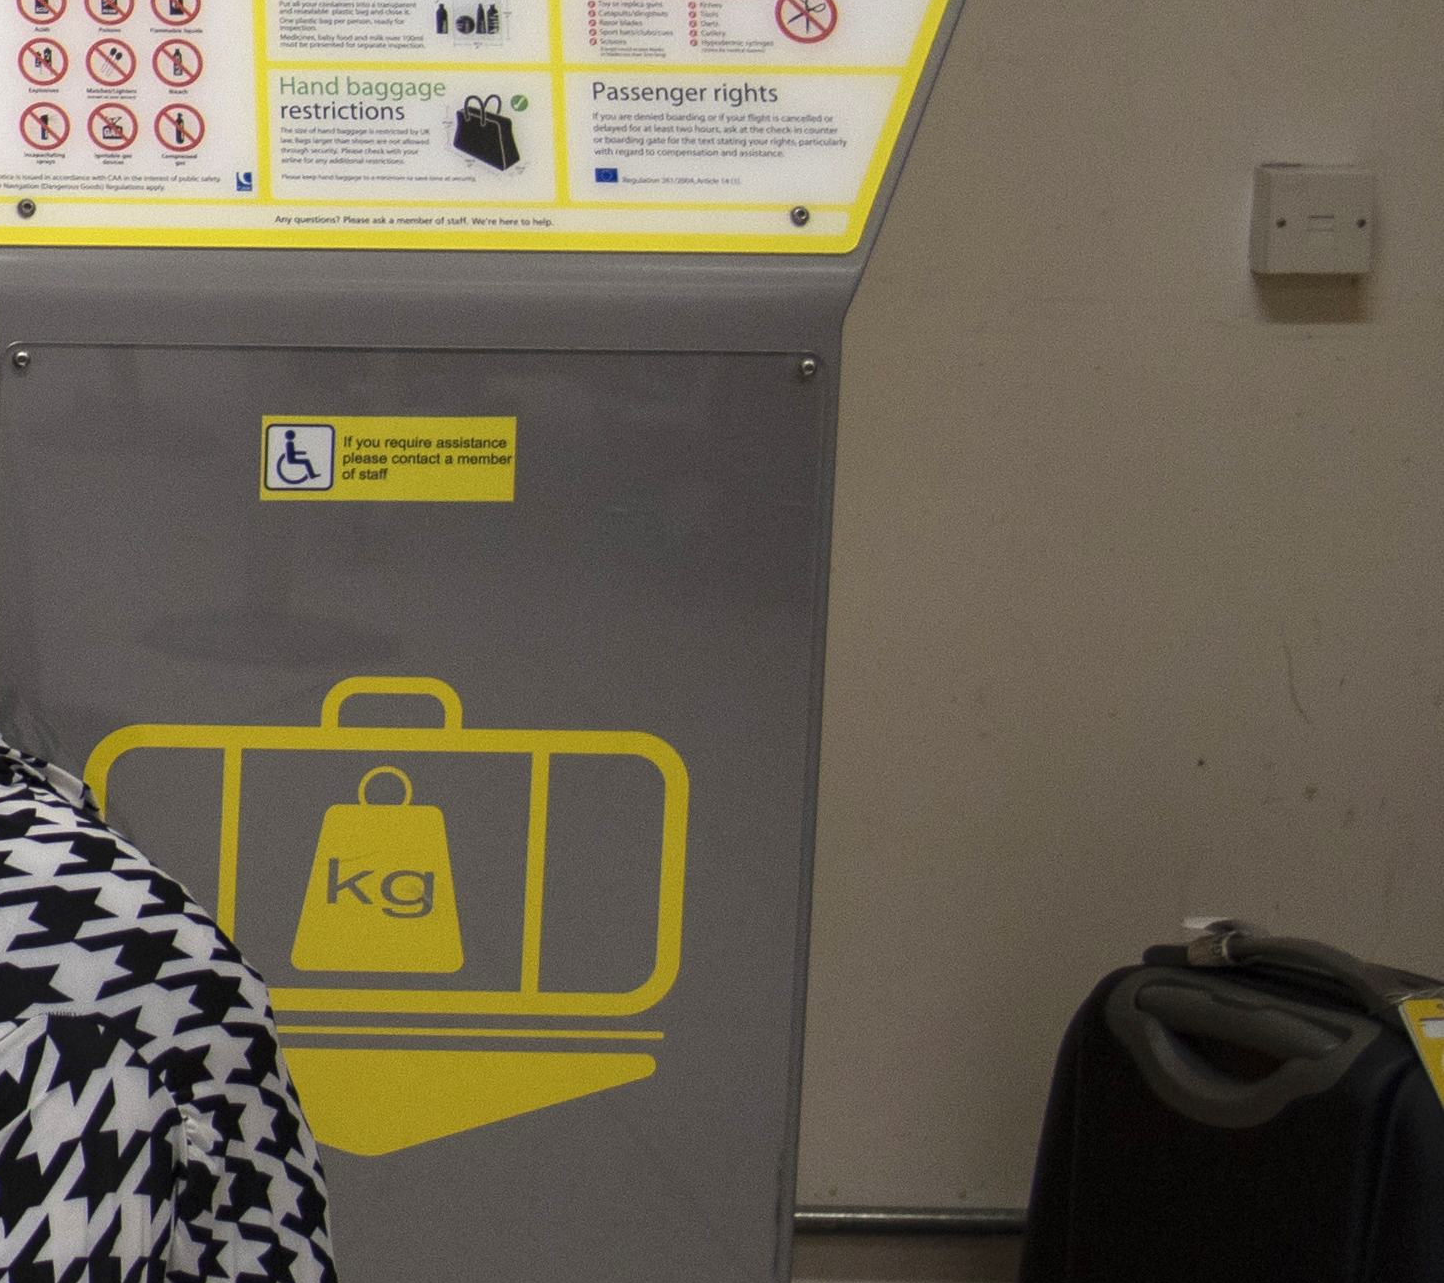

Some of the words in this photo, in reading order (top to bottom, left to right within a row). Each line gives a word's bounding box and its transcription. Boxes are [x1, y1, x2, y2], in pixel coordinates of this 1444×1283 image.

[279, 76, 339, 96] Hand
[346, 76, 446, 102] baggage
[592, 80, 706, 107] Passenger
[713, 81, 778, 108] rights
[279, 100, 405, 120] restrictions
[274, 215, 292, 224] Any
[293, 215, 340, 224] questions?
[343, 215, 370, 224] Please
[372, 216, 386, 224] ask
[396, 216, 432, 224] member
[434, 216, 444, 225] of
[447, 216, 467, 225] staff.
[471, 217, 497, 225] We're
[498, 217, 518, 225] here
[532, 217, 553, 227] help.
[343, 435, 352, 447] If
[355, 438, 380, 450] you
[384, 436, 432, 450] require
[435, 436, 507, 449] assistance
[342, 453, 387, 466] please
[391, 453, 440, 464] contact
[444, 455, 453, 464] a
[457, 453, 512, 465] member
[341, 468, 355, 480] of
[358, 467, 388, 480] staff
[326, 858, 436, 919] kg
